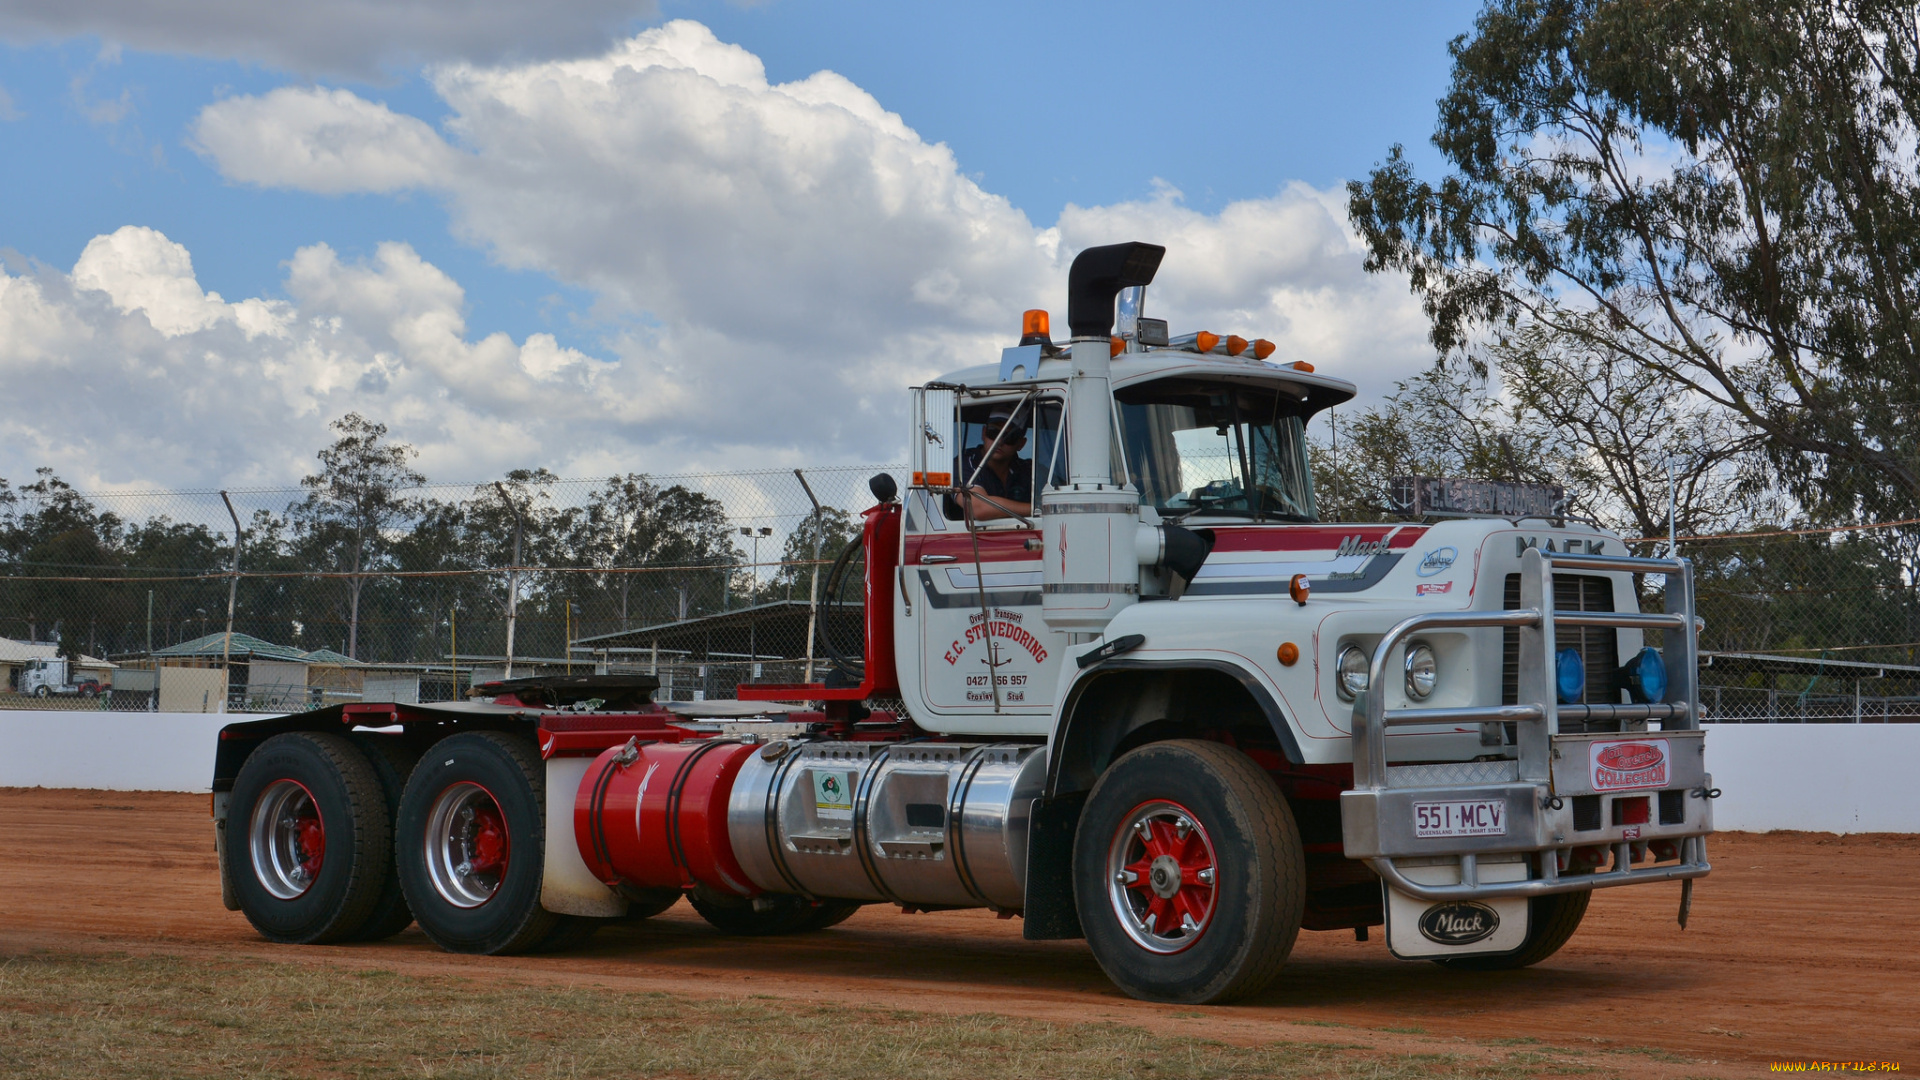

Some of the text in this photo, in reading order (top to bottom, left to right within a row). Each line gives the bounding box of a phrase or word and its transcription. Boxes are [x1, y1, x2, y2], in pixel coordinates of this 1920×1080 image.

[1336, 535, 1390, 557] Mack
[994, 607, 1023, 623] Transport
[944, 640, 966, 666] E.C.
[966, 675, 1027, 686] 0427 56 957
[1007, 691, 1024, 701] Stud
[1603, 747, 1621, 763] Jon
[1596, 762, 1666, 787] COLLECTION
[1434, 913, 1484, 933] Mack
